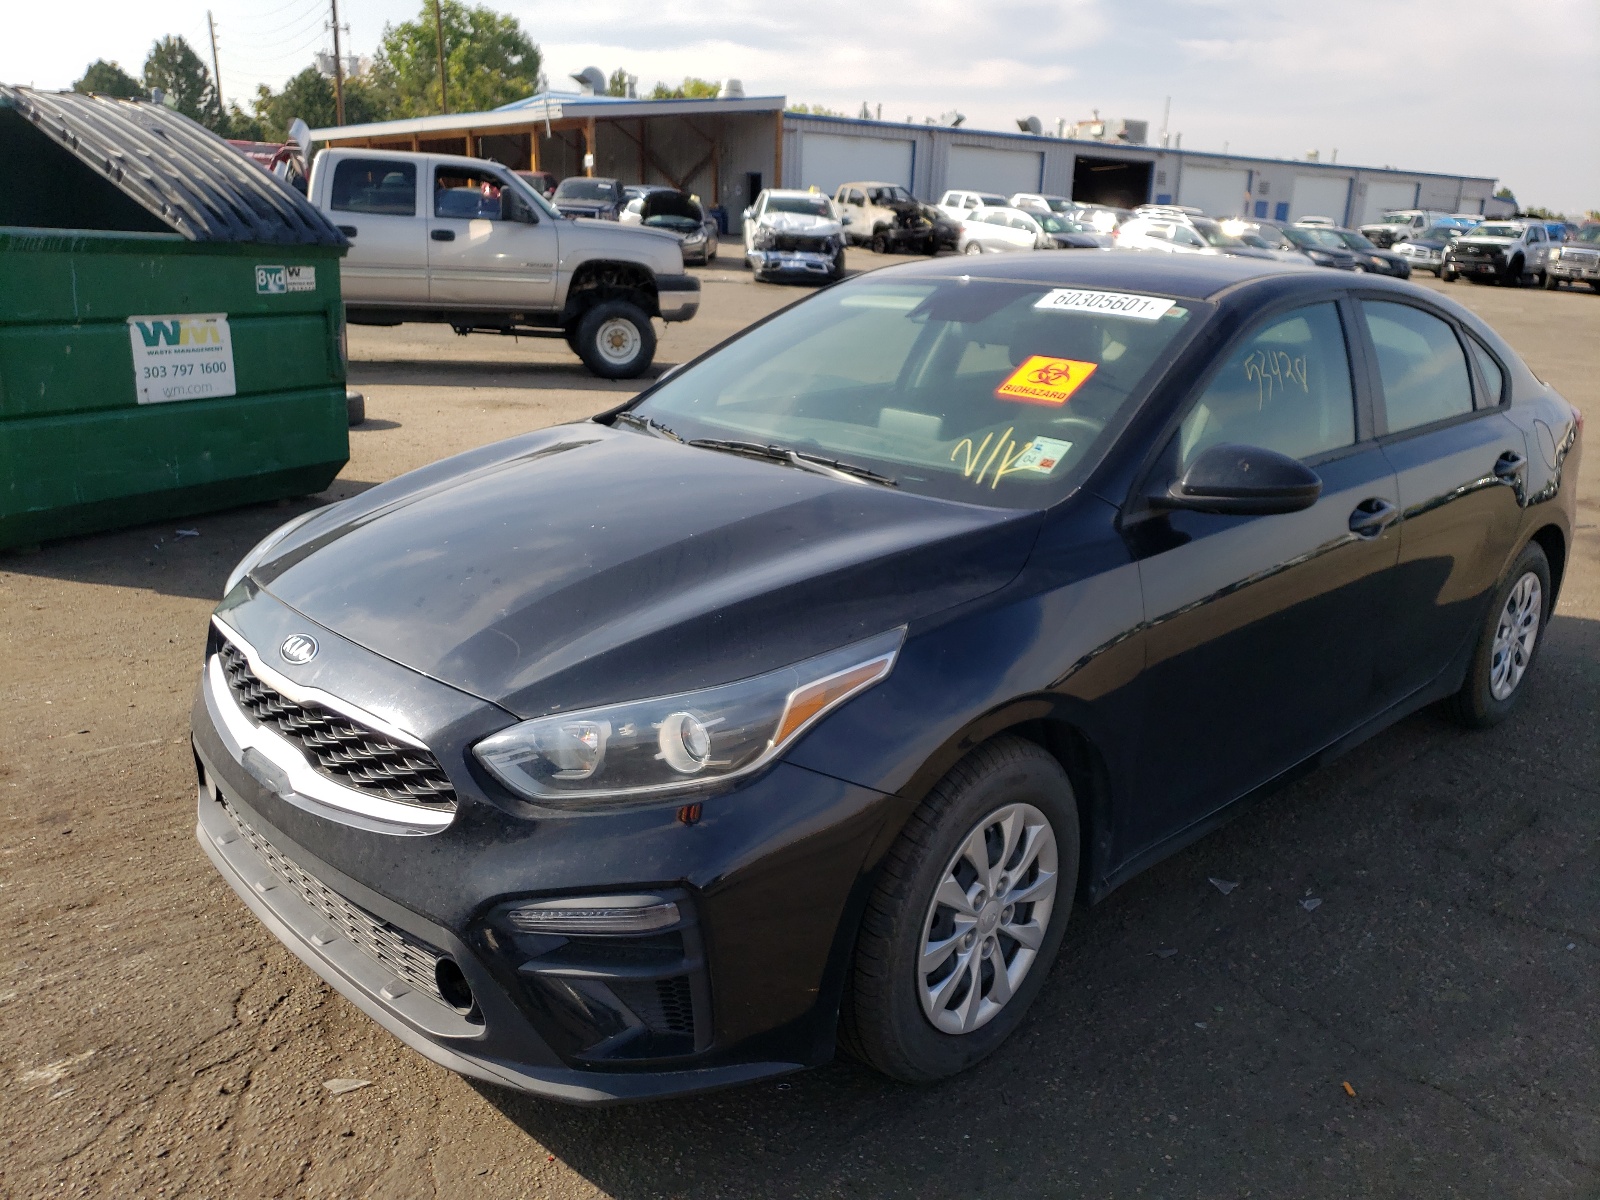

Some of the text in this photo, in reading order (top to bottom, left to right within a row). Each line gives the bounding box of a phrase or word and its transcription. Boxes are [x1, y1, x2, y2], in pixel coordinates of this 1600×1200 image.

[134, 320, 220, 347] WM
[174, 346, 223, 354] MANAGEMENT
[143, 361, 227, 379] 303 797 1600
[162, 382, 213, 398] wm.com
[1003, 384, 1067, 400] BIOHAZARD
[283, 636, 312, 661] KIA
